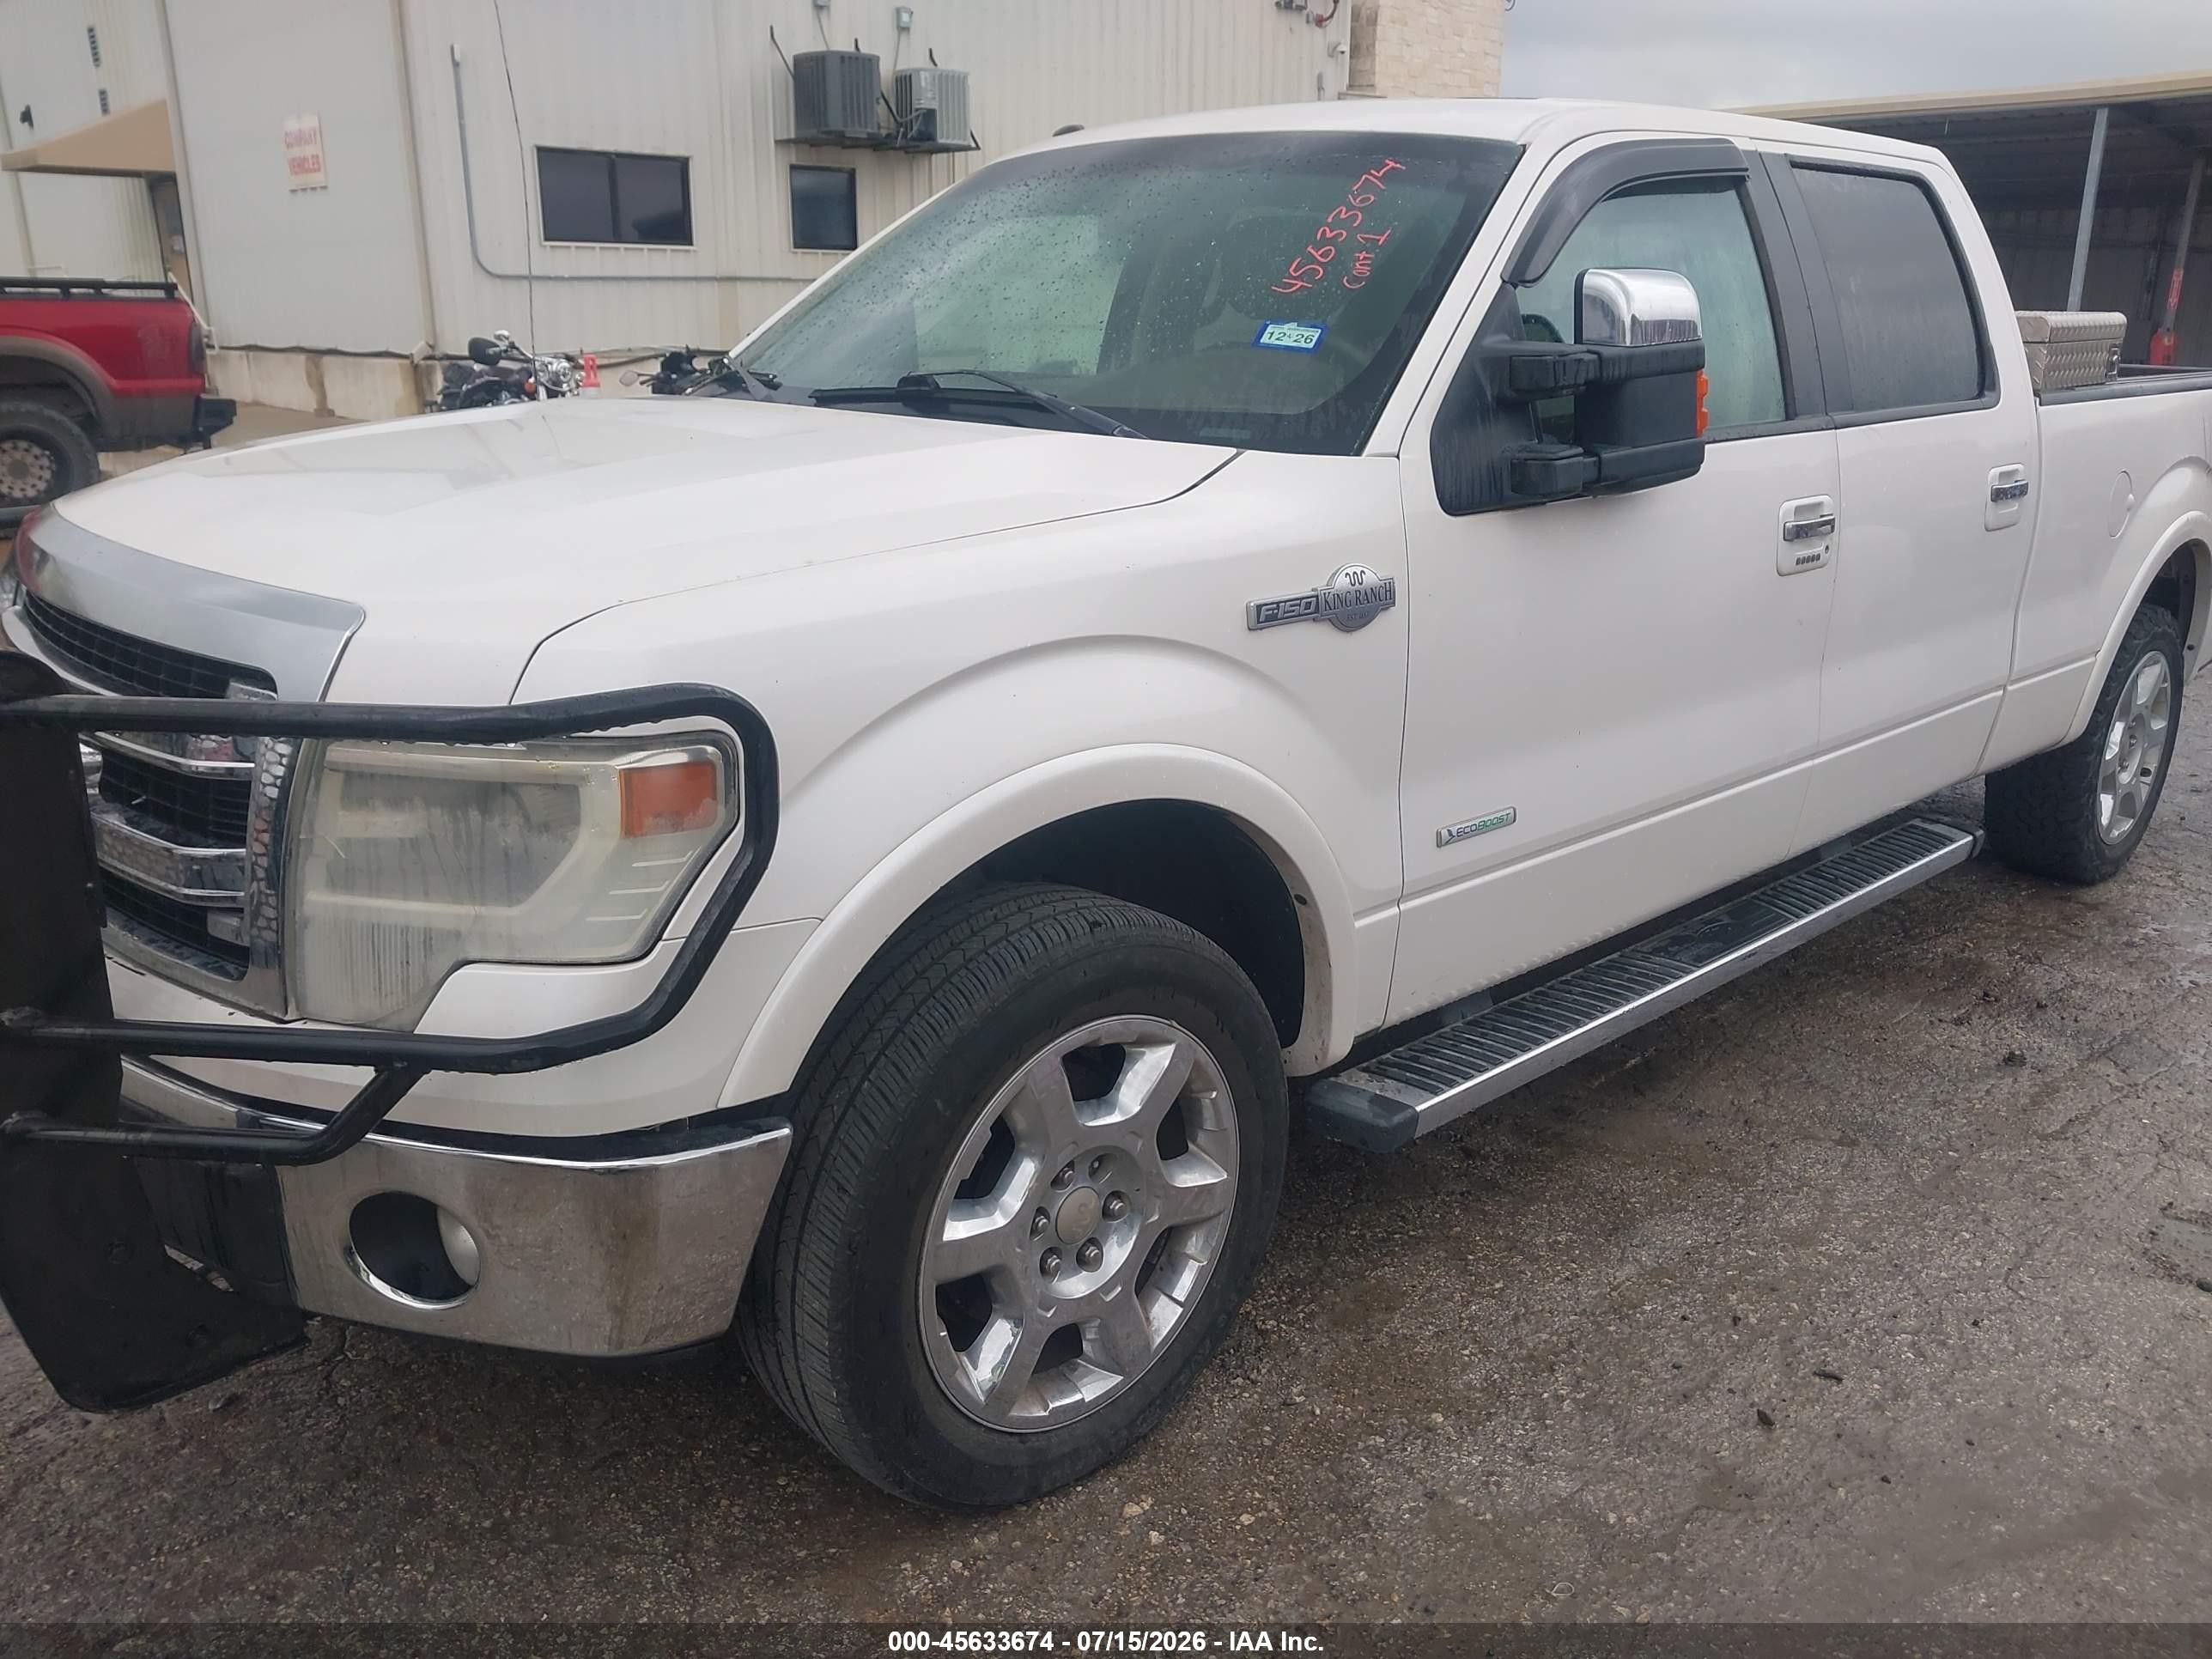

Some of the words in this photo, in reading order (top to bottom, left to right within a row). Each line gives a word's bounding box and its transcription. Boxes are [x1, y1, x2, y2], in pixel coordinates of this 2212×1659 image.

[1271, 159, 1407, 293] 45633674
[1356, 228, 1393, 246] 1
[1267, 331, 1286, 342] 12
[1292, 333, 1315, 344] 26
[1323, 590, 1352, 612] KING
[1355, 581, 1393, 606] RANCH
[1259, 599, 1317, 623] F-150
